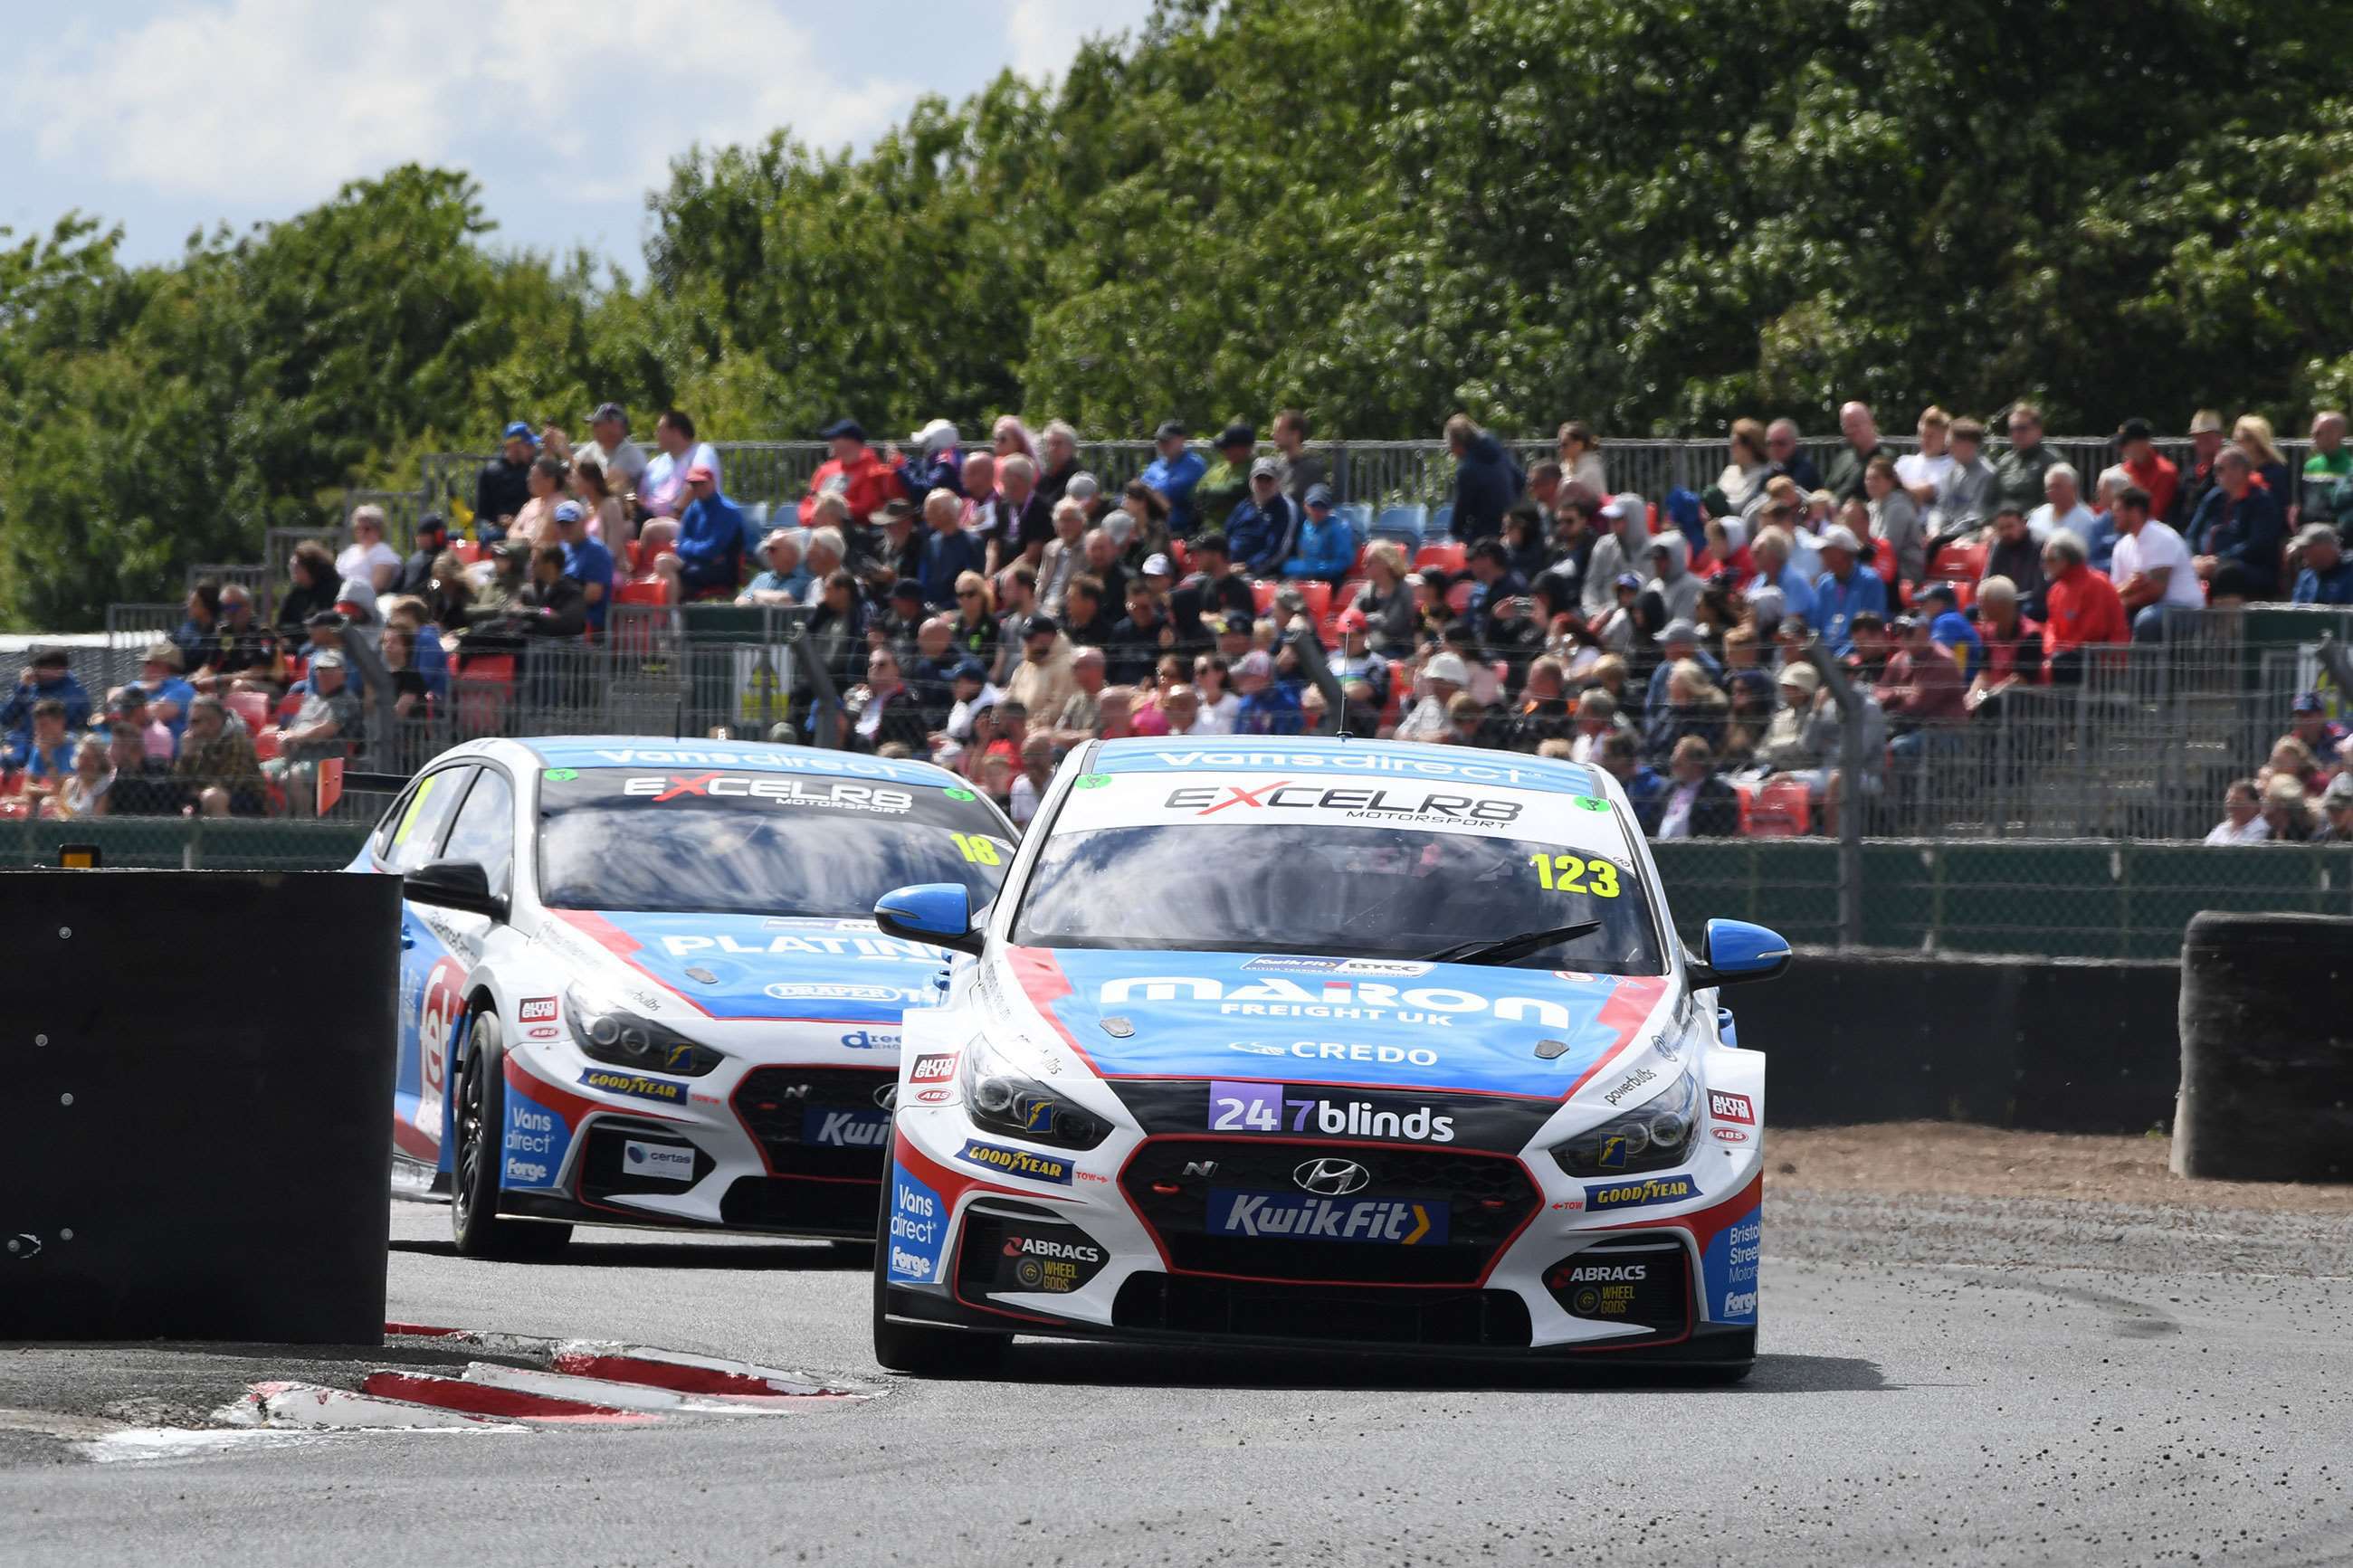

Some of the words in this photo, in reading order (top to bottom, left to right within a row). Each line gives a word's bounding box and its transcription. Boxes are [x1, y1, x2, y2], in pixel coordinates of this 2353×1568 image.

[624, 773, 912, 810] EXCELR8
[776, 798, 910, 814] MOTORSPORT
[1164, 781, 1523, 821] EXCELR8
[1347, 811, 1511, 829] MOTORSPORT
[949, 832, 1000, 866] 18
[1531, 853, 1620, 898] 123
[1221, 1003, 1387, 1020] FREIGHT
[1397, 1012, 1453, 1026] UK
[1291, 1041, 1438, 1066] CREDO
[918, 1058, 954, 1069] AUTO
[914, 1067, 953, 1079] GLYM
[920, 1090, 950, 1099] ABS
[1604, 1069, 1657, 1106] powerbulbs
[1713, 1095, 1748, 1107] AUTO
[512, 1107, 551, 1132] Vans
[1713, 1103, 1750, 1118] GLYM
[506, 1129, 551, 1154] direct
[1716, 1130, 1743, 1139] ABS
[650, 1152, 691, 1164] certas
[969, 1146, 1062, 1177] GOODYEAR
[1076, 1172, 1097, 1182] TOW
[900, 1184, 932, 1217] Vans
[1596, 1180, 1688, 1203] GOODYEAR
[1564, 1202, 1583, 1210] TOW
[891, 1212, 935, 1244] direct
[1021, 1239, 1098, 1262] ABRACS
[1043, 1260, 1077, 1278] WHEEL
[1569, 1265, 1646, 1281] ABRACS
[1043, 1277, 1069, 1291] GODS
[1602, 1285, 1635, 1299] WHEEL
[1601, 1299, 1627, 1314] GODS
